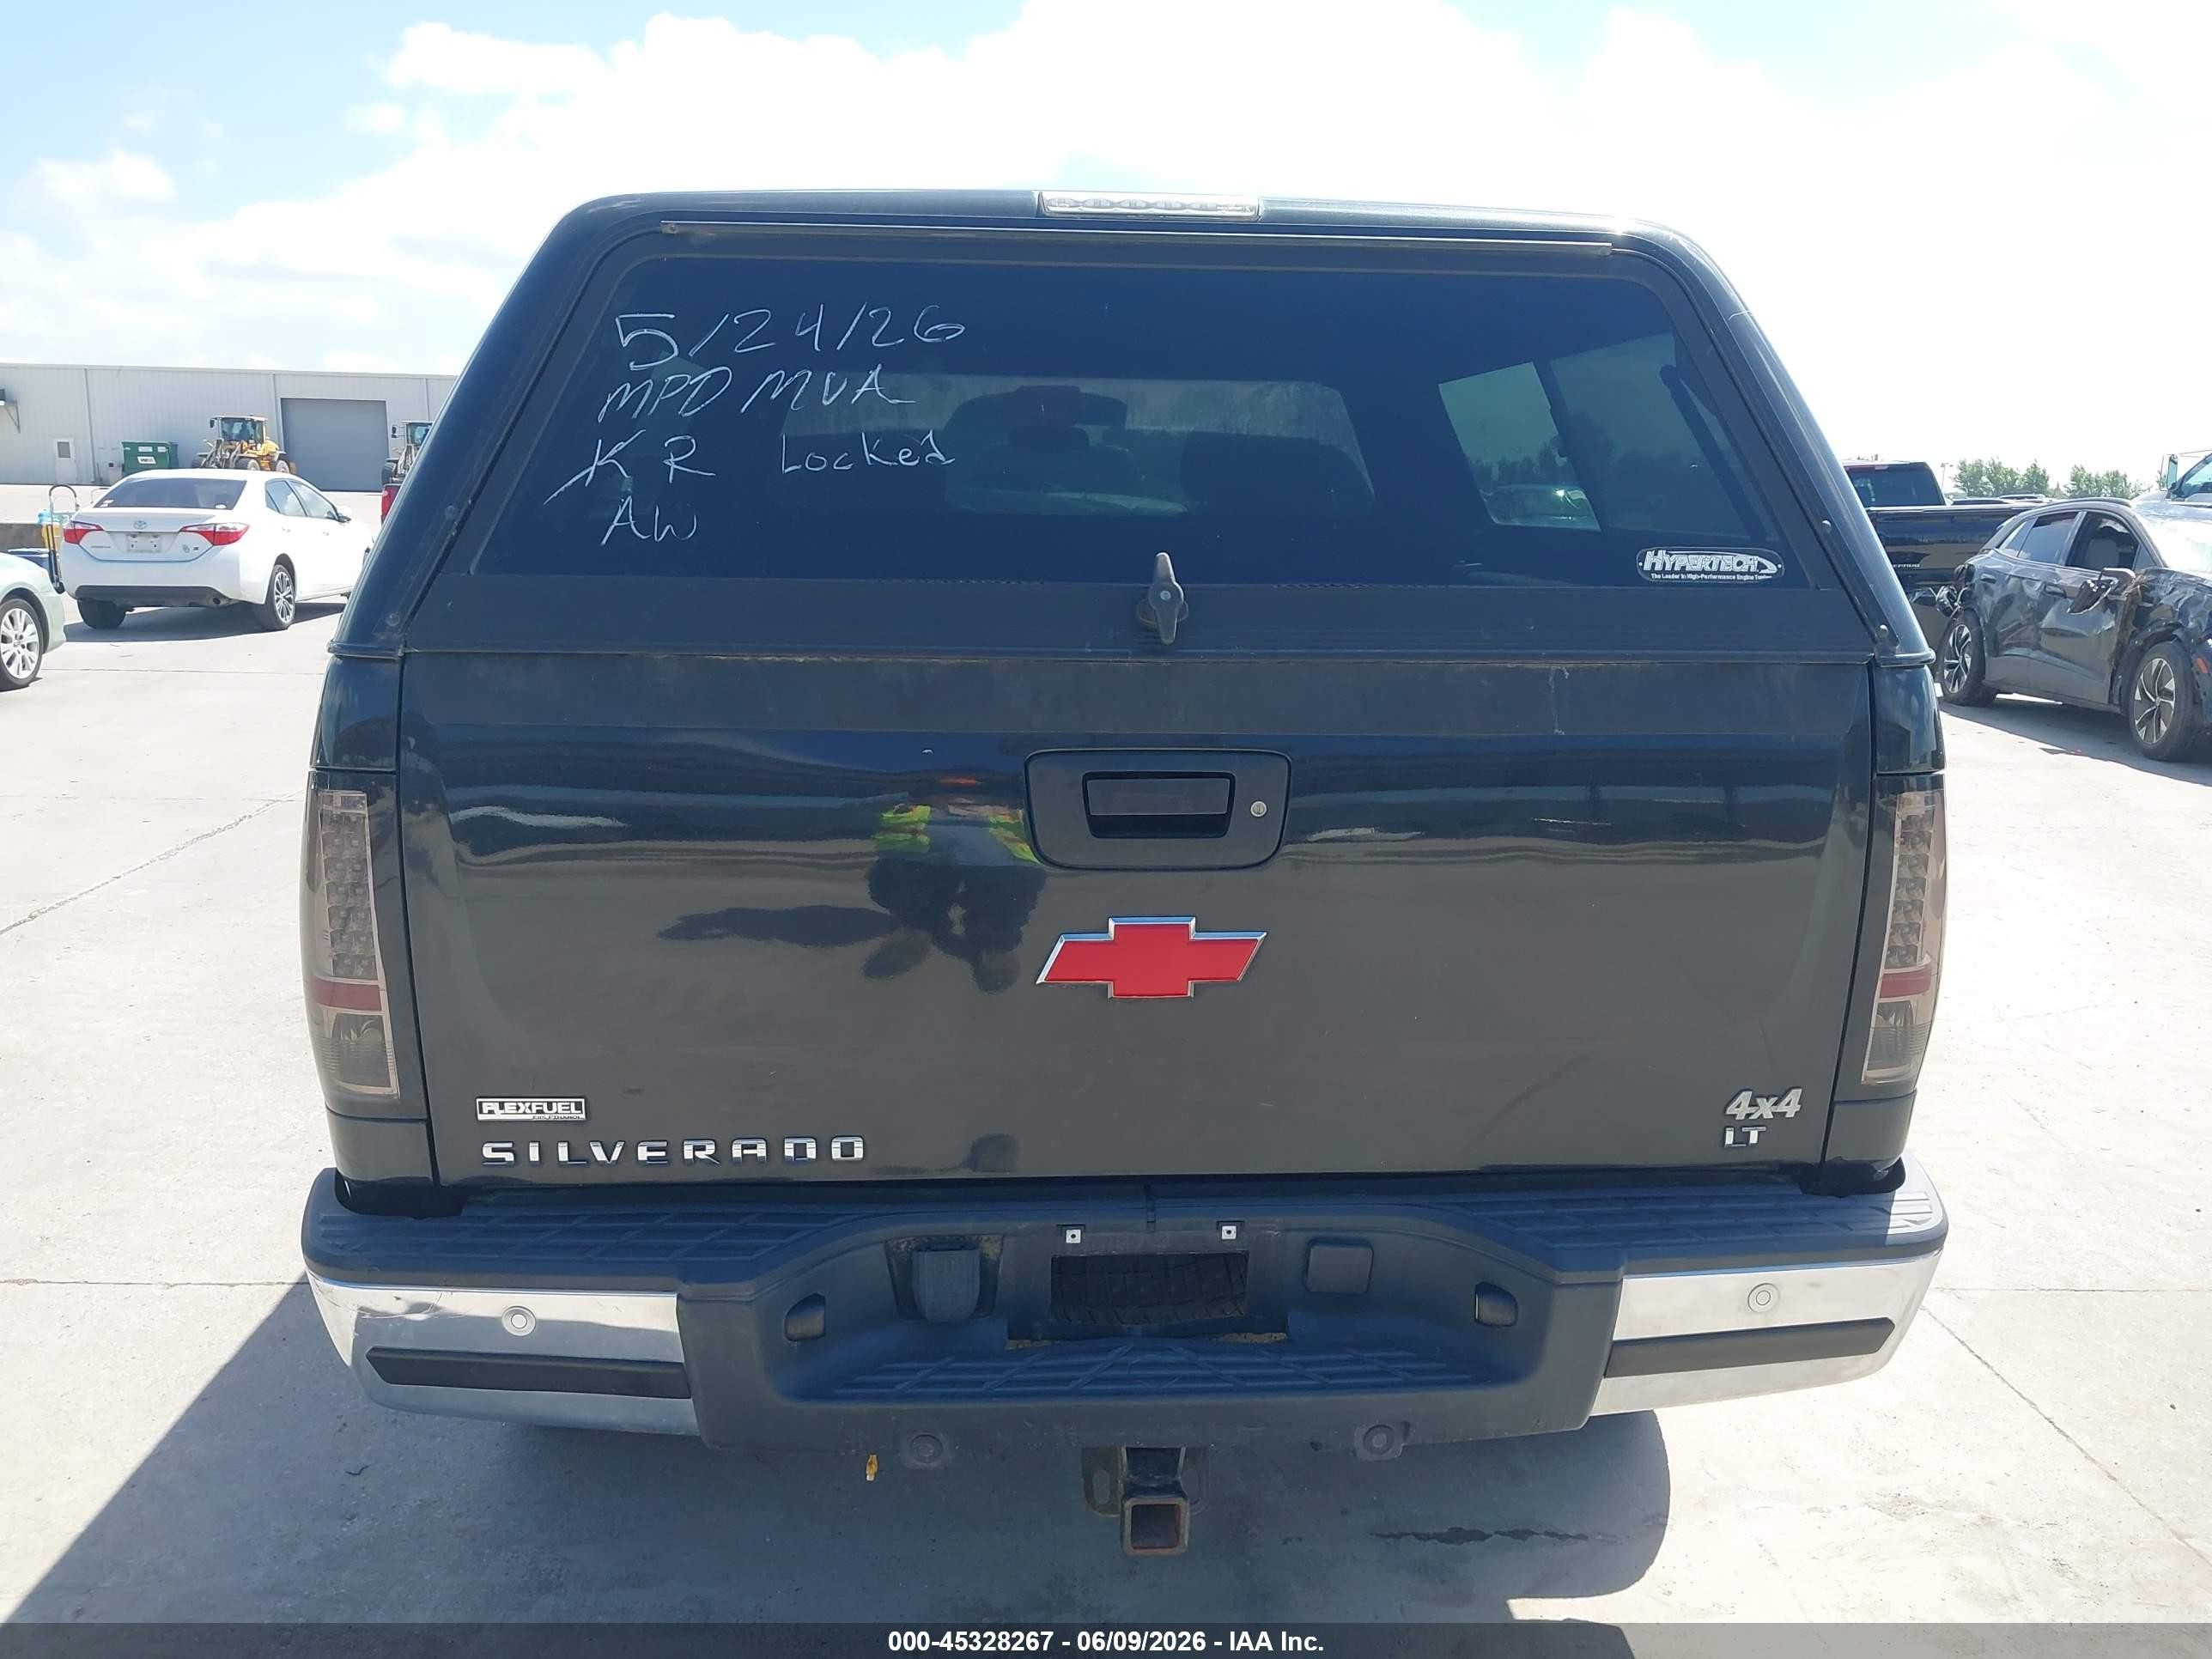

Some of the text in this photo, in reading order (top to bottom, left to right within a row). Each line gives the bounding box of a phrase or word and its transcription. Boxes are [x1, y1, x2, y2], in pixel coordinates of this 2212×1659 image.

[1643, 550, 1759, 572] HYPERTECH
[1725, 1088, 1802, 1121] 4x4
[482, 1137, 865, 1165] SILVERADO
